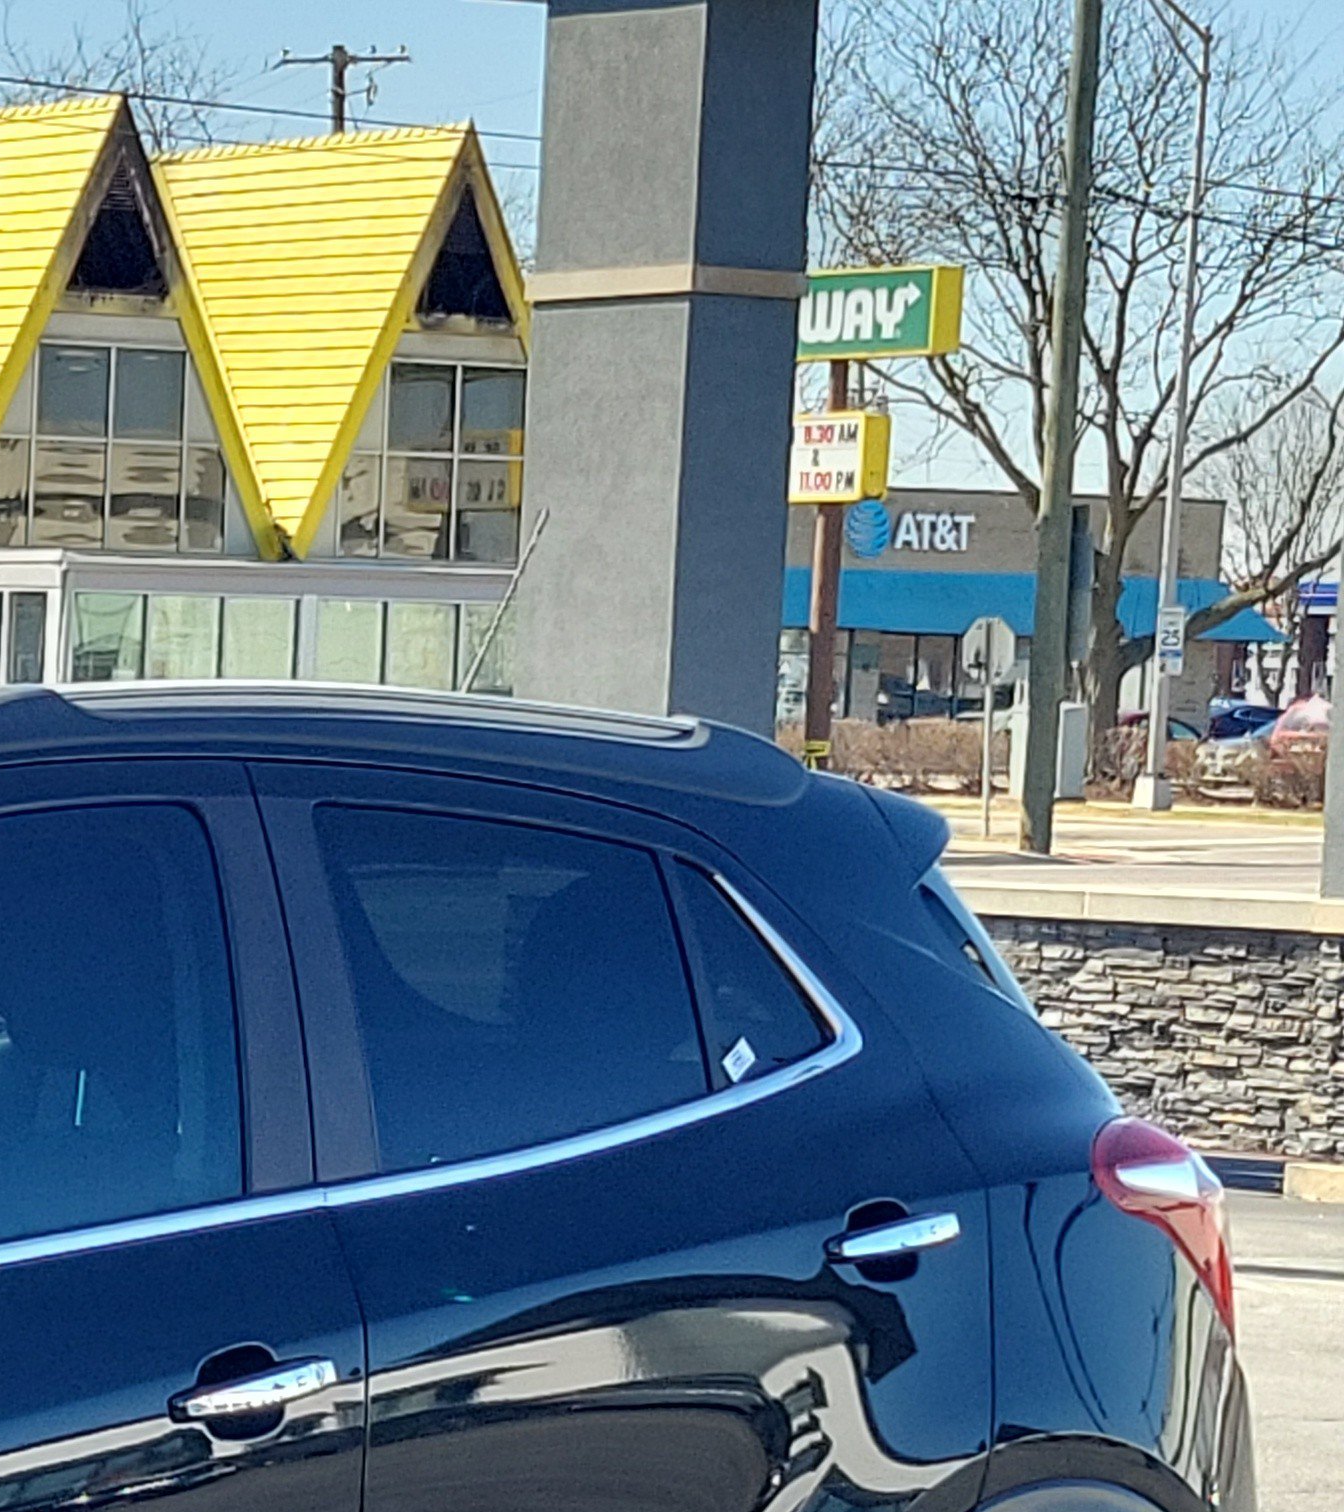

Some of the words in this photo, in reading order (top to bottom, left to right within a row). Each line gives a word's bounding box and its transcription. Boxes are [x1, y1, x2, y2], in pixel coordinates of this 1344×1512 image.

[839, 423, 859, 443] AM
[836, 470, 855, 493] PM
[894, 512, 976, 551] AT&T
